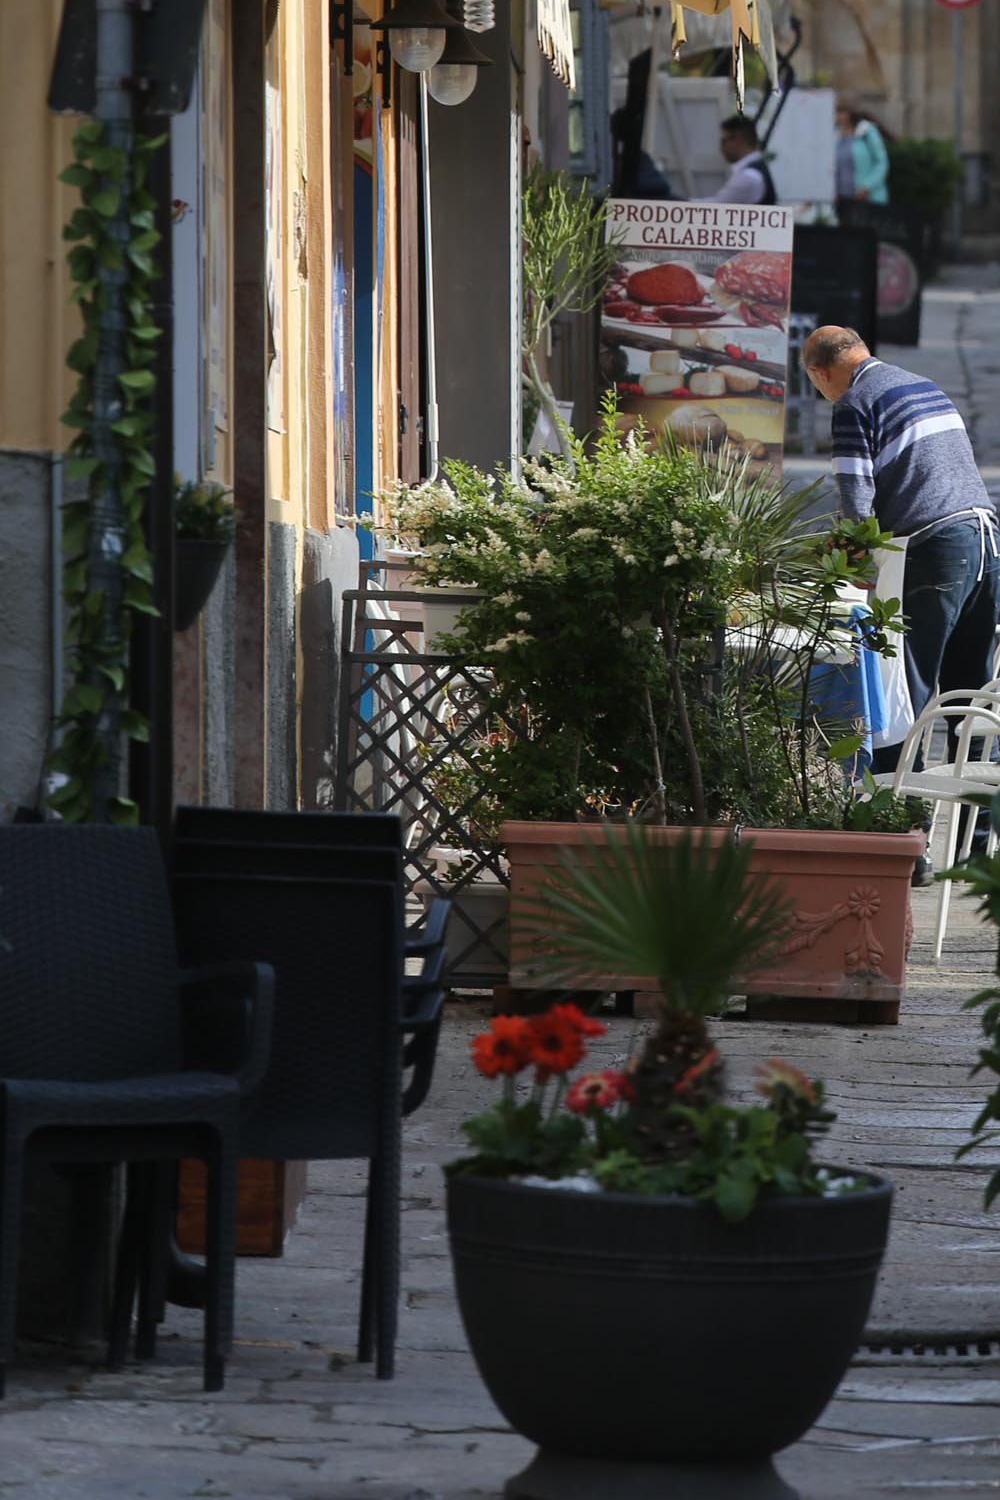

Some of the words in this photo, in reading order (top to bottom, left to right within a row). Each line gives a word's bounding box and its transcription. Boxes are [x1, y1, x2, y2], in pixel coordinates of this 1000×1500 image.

[614, 204, 718, 225] PRODOTTI
[725, 209, 787, 228] TIPICI
[642, 227, 756, 248] CALABRESI
